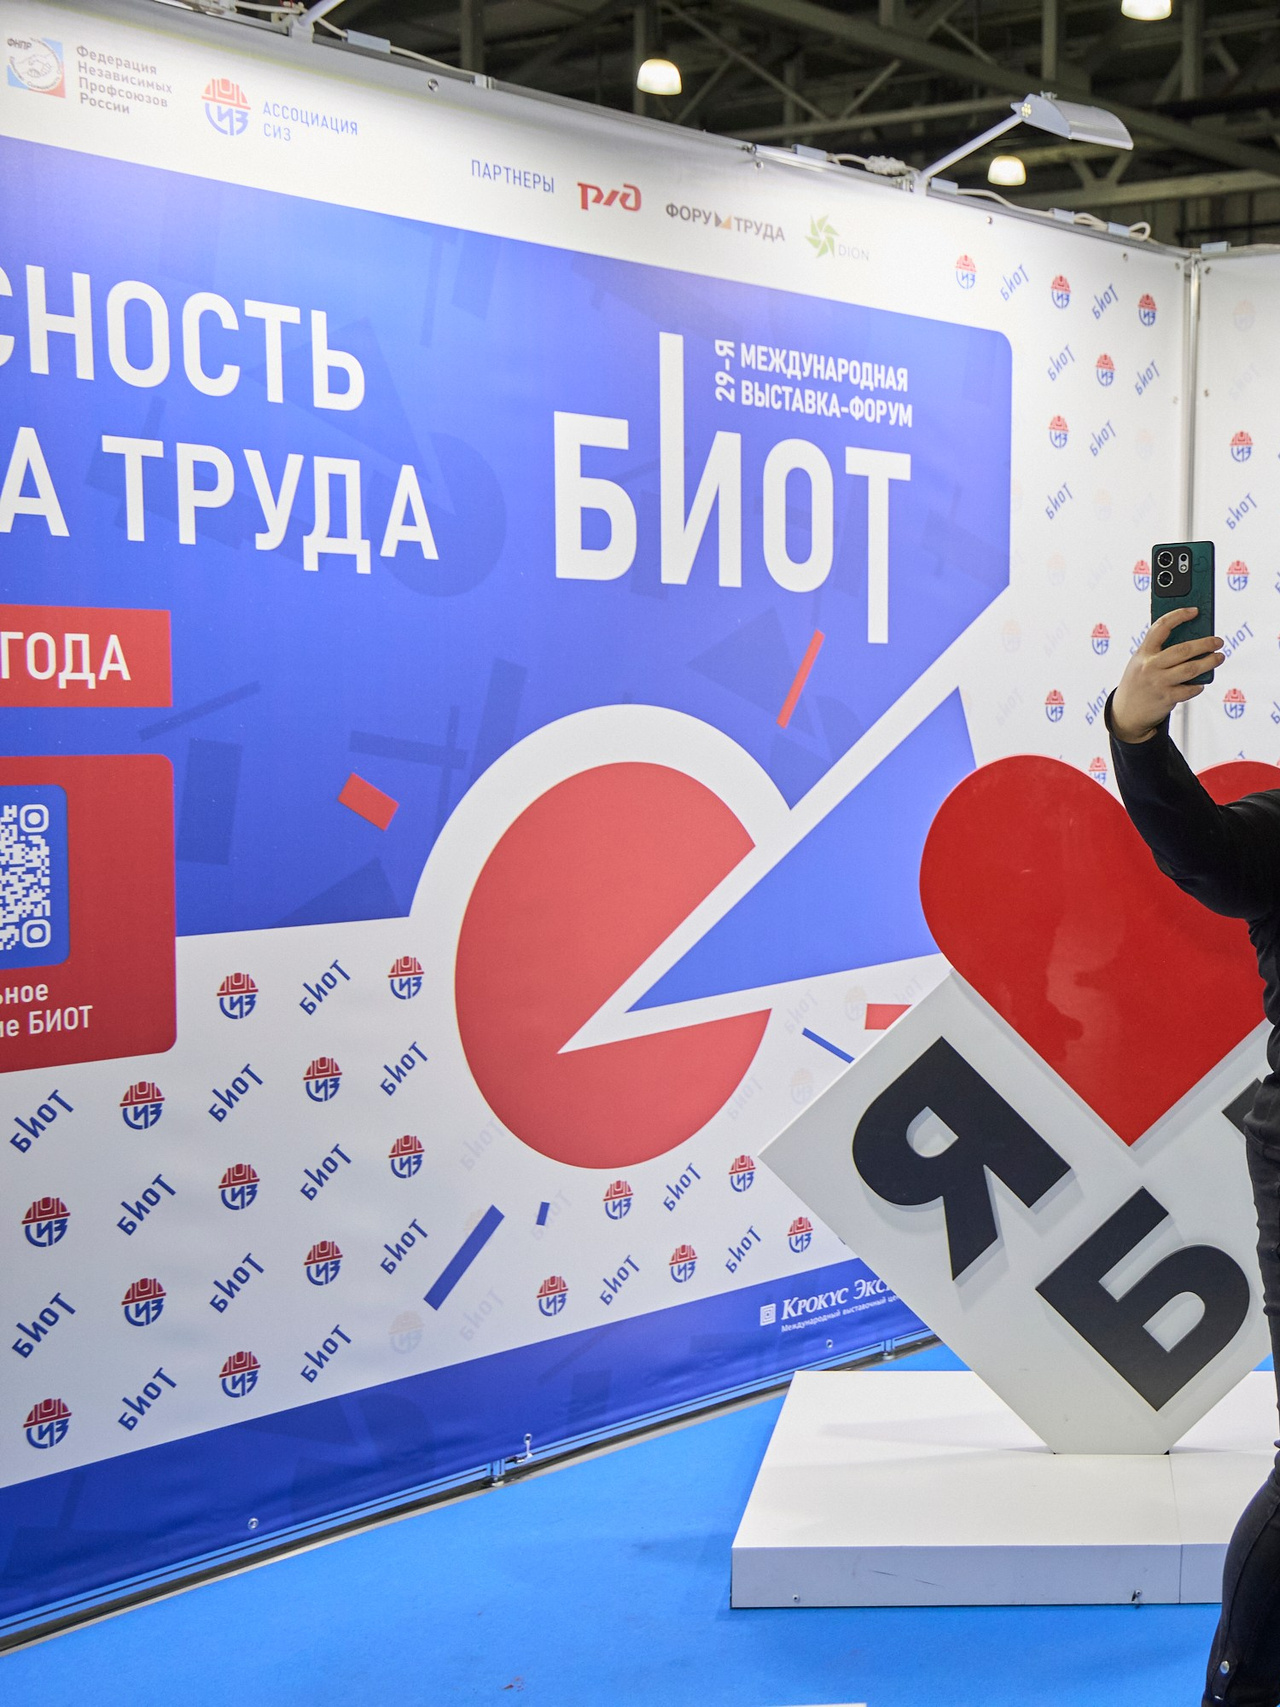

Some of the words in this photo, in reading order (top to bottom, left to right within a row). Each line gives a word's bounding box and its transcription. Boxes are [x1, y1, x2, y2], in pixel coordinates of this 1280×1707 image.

[76, 45, 157, 75] Федерация
[78, 60, 172, 94] Независимых
[79, 76, 168, 107] Профсоюзов
[80, 92, 130, 114] России
[262, 101, 358, 136] АССОЦИАЦИЯ
[263, 123, 291, 142] СИЗ
[471, 159, 555, 193] ПАРТНЕРЫ
[734, 216, 786, 242] ТРУДА
[838, 243, 870, 261] DION
[0, 264, 365, 411] НОСТЬ
[740, 342, 909, 392] МЕЖДУНАРОДНАЯ
[741, 380, 914, 428] ВЫСТАВКА-ФОРУМ
[102, 434, 439, 574] ТРУДА
[554, 332, 911, 644] БИОТ
[0, 631, 131, 689] ГОДА
[300, 960, 351, 1015] БИОТ
[29, 1005, 93, 1035] БИОТ
[209, 1065, 264, 1122] БИОТ
[381, 1042, 428, 1096] БИОТ
[11, 1090, 74, 1152] БИОТ
[301, 1144, 352, 1200] БИОТ
[852, 1036, 1071, 1281] Я
[118, 1174, 176, 1235] БИОТ
[663, 1162, 702, 1211] БИОТ
[381, 1219, 428, 1275] БИОТ
[725, 1228, 762, 1274] БИОТ
[210, 1254, 264, 1312] БИОТ
[600, 1256, 640, 1306] БИОТ
[14, 1293, 76, 1358] БИОТ
[301, 1326, 352, 1383] БИОТ
[118, 1368, 177, 1431] БИОТ
